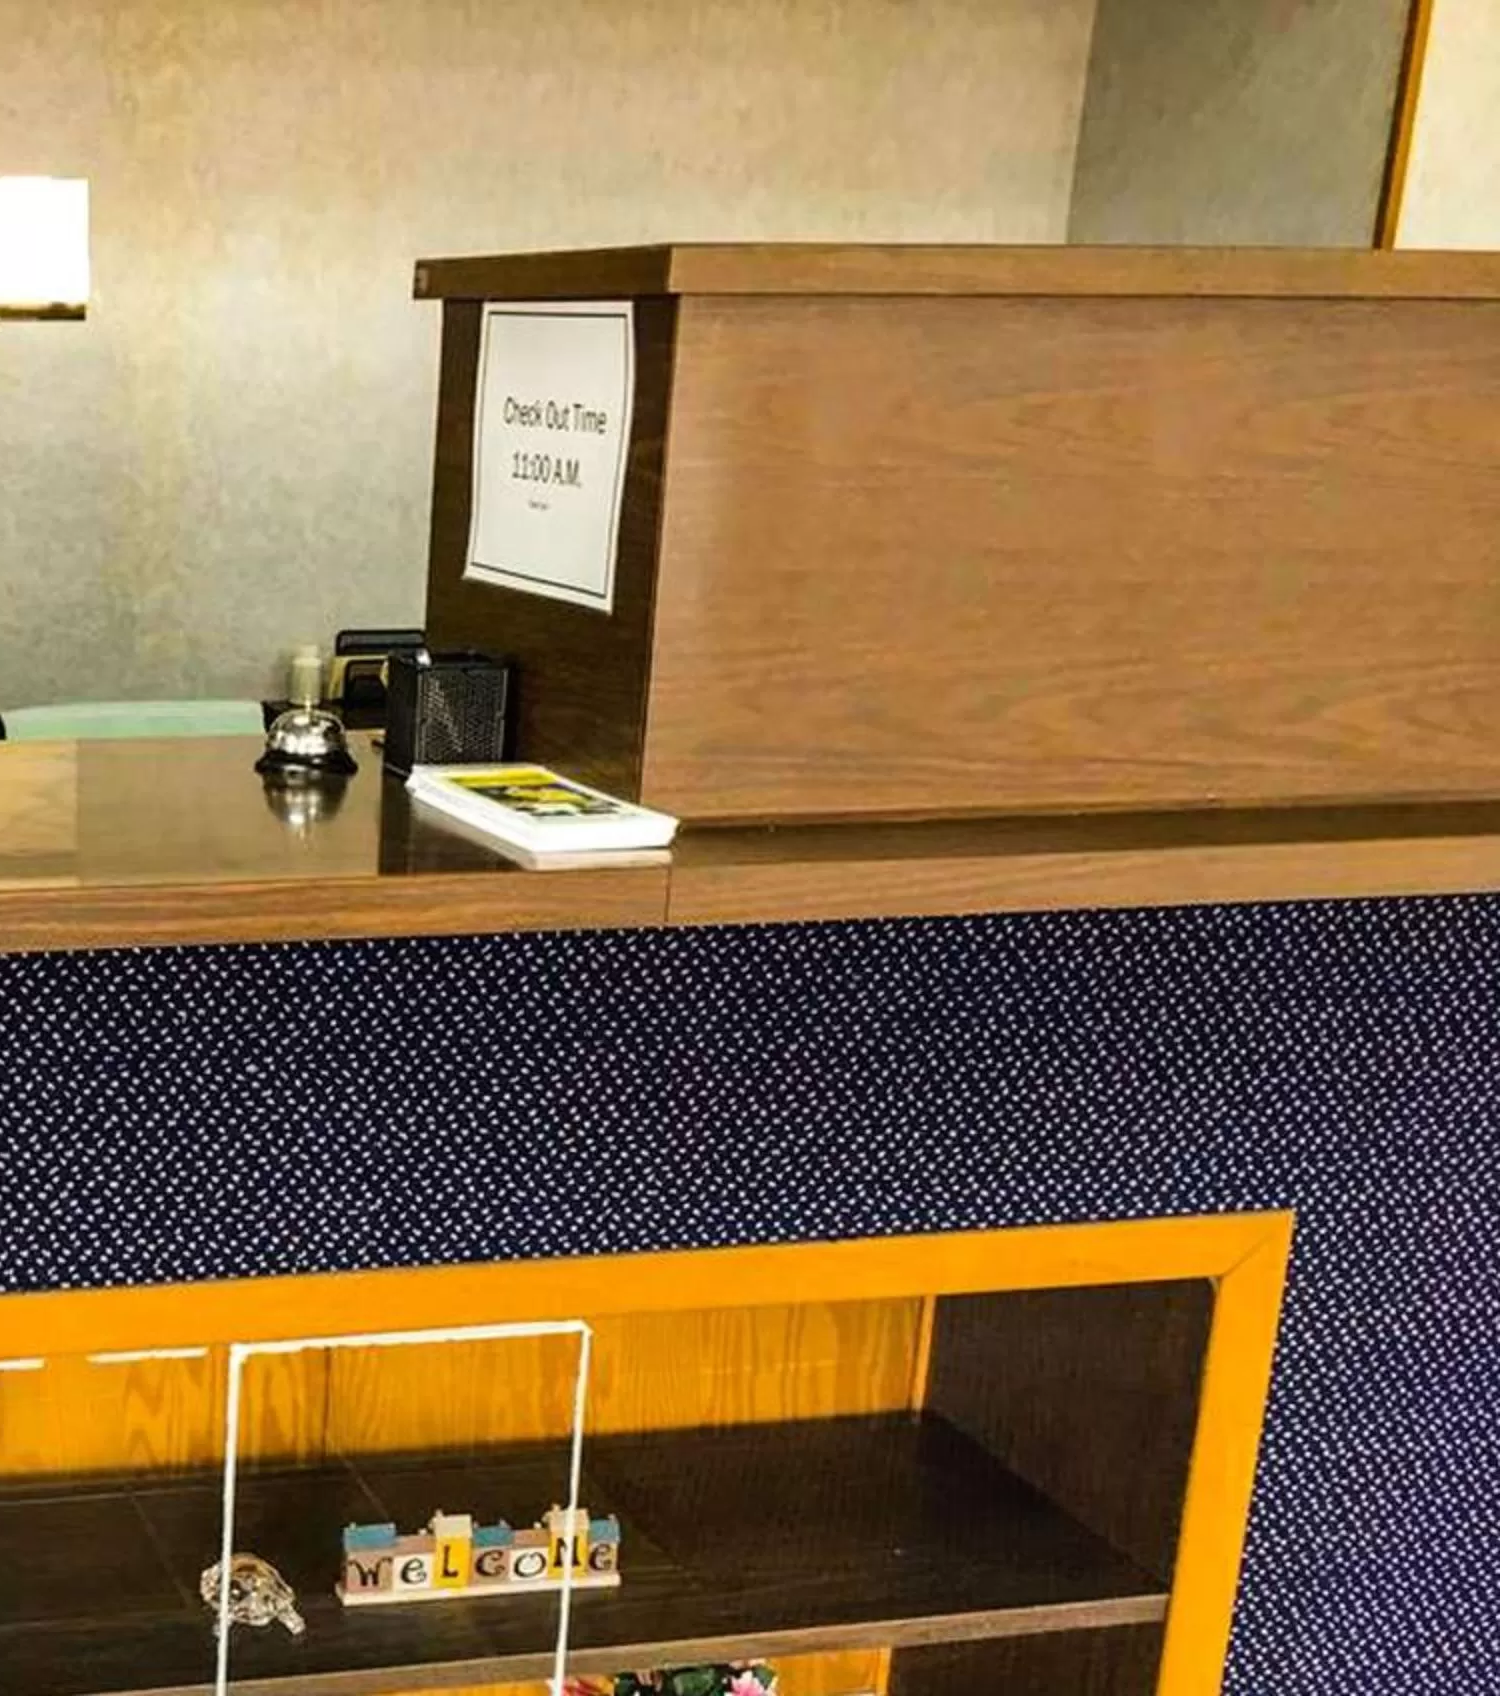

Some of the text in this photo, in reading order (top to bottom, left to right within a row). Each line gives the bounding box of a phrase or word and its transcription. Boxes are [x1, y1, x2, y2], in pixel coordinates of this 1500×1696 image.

[503, 395, 607, 436] Check Out Time
[512, 450, 552, 484] 11:00
